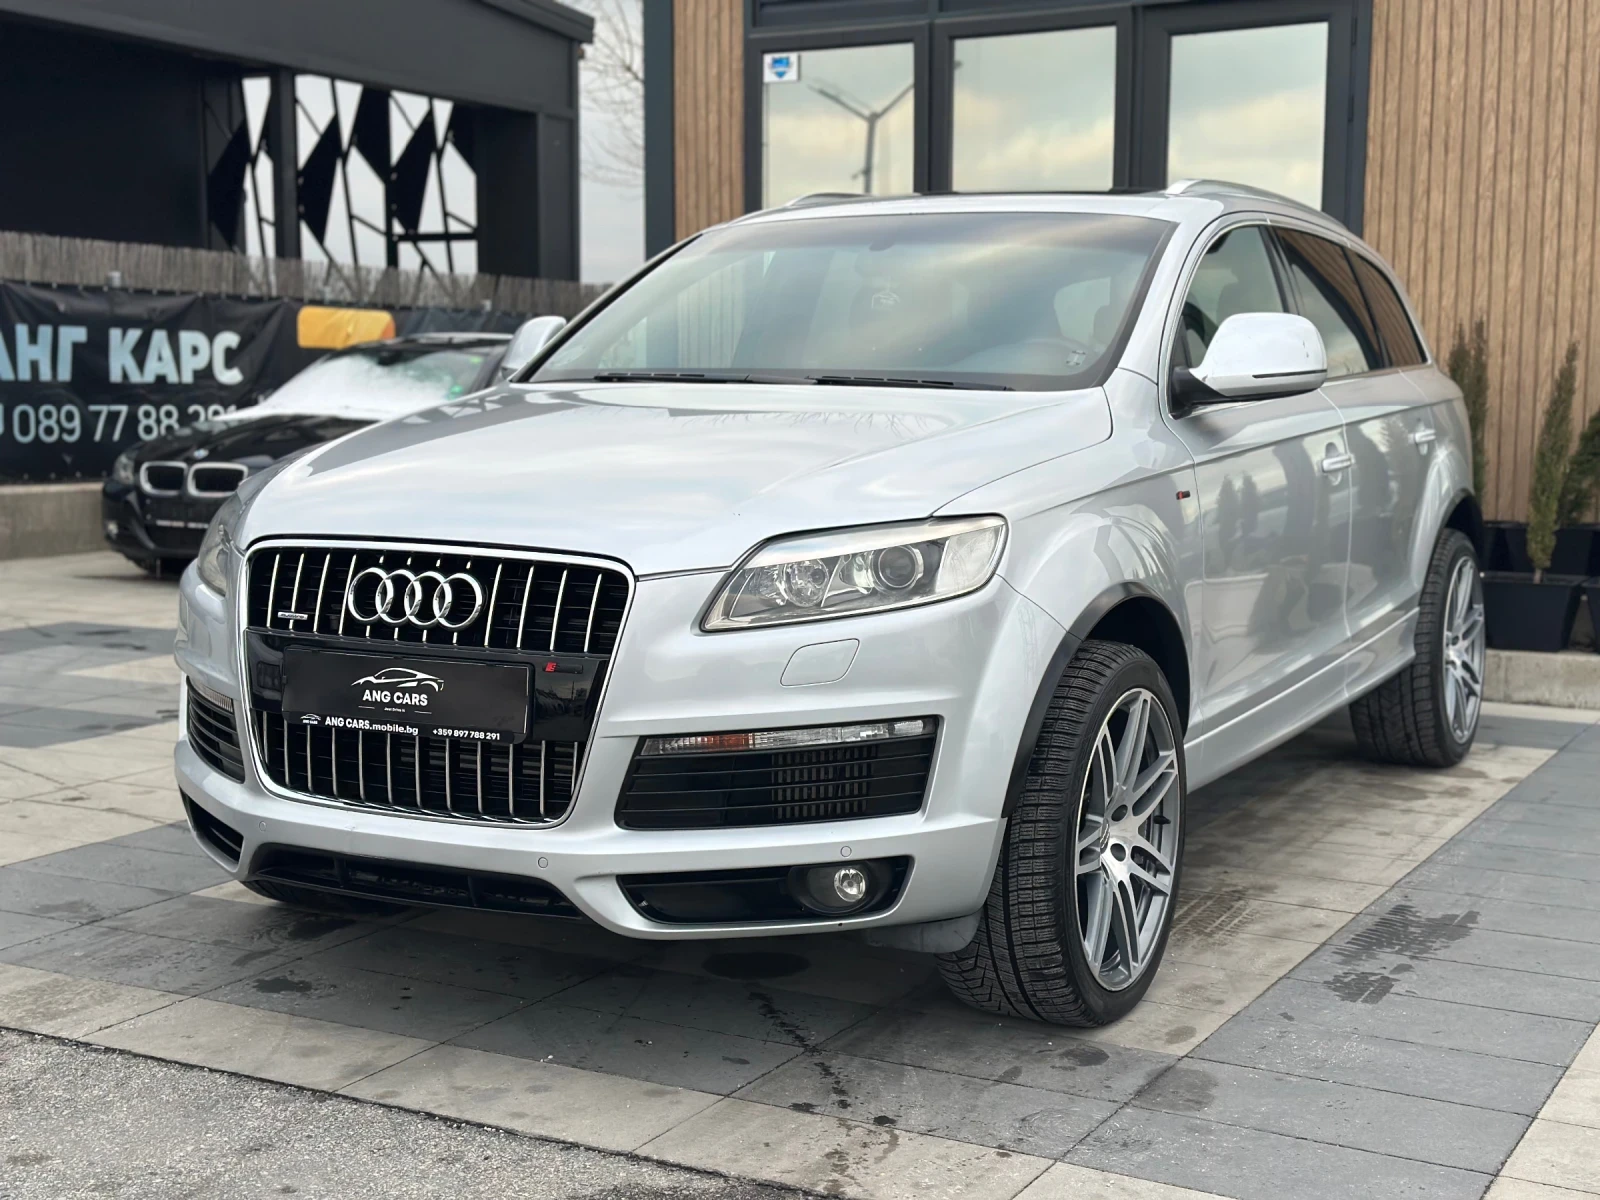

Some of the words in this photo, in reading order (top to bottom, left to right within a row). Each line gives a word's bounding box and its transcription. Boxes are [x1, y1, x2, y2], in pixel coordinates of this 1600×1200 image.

[108, 327, 244, 385] КАРС
[13, 404, 81, 443] 089
[88, 405, 129, 442] 77
[137, 404, 180, 441] 88
[362, 689, 391, 703] ANG
[393, 691, 428, 706] CARS
[325, 716, 344, 728] ANG
[345, 718, 419, 736] CARS.mobile.bg
[432, 728, 453, 737] +359
[453, 729, 468, 738] 897
[469, 730, 485, 739] 788
[485, 732, 500, 740] 291
